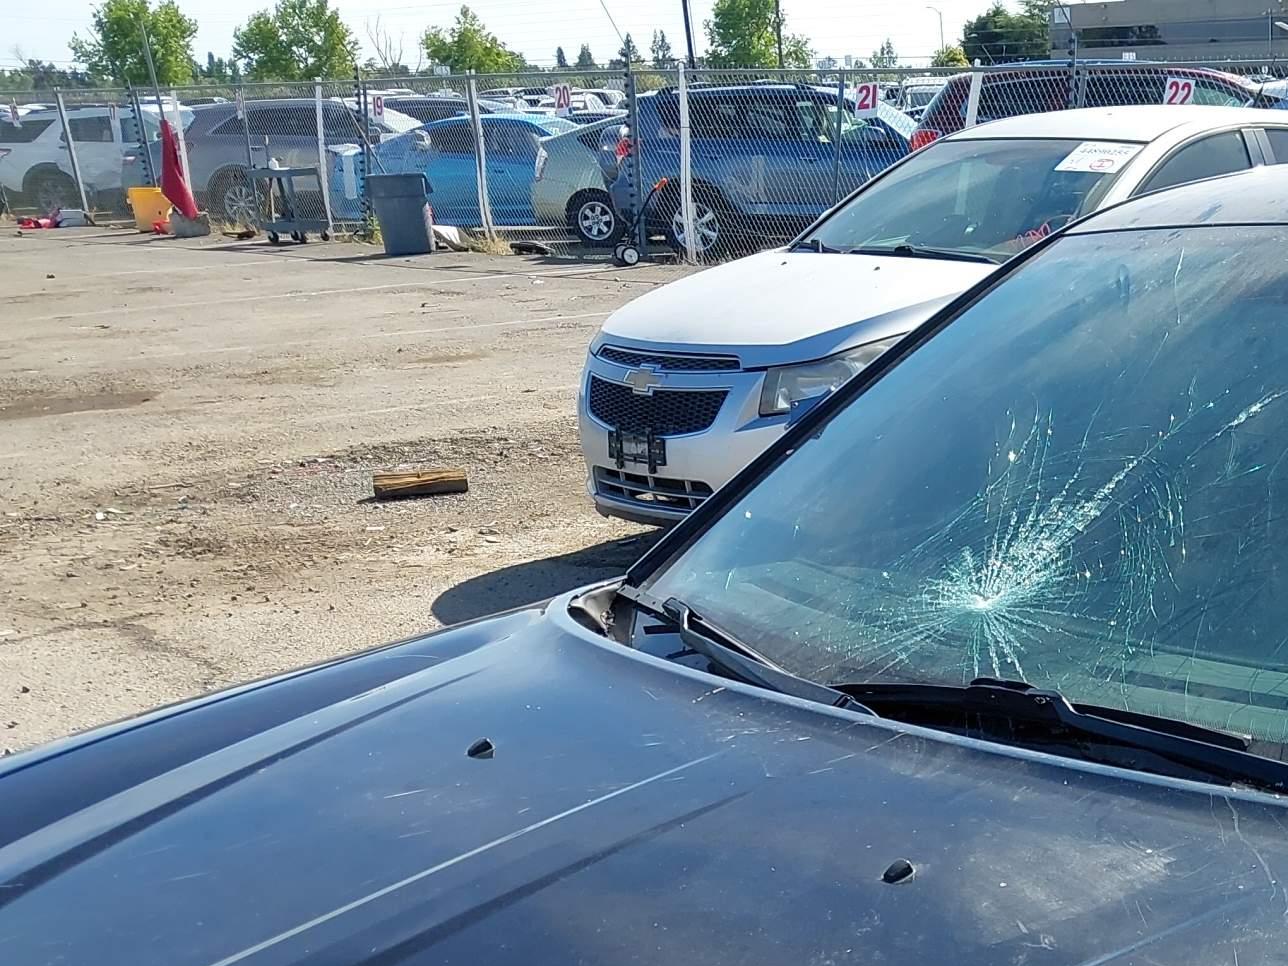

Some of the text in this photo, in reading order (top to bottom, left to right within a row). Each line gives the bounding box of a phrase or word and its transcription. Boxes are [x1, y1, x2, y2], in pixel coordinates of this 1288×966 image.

[555, 85, 570, 109] 20
[857, 84, 878, 110] 21
[1167, 80, 1192, 105] 22
[373, 96, 384, 116] 19
